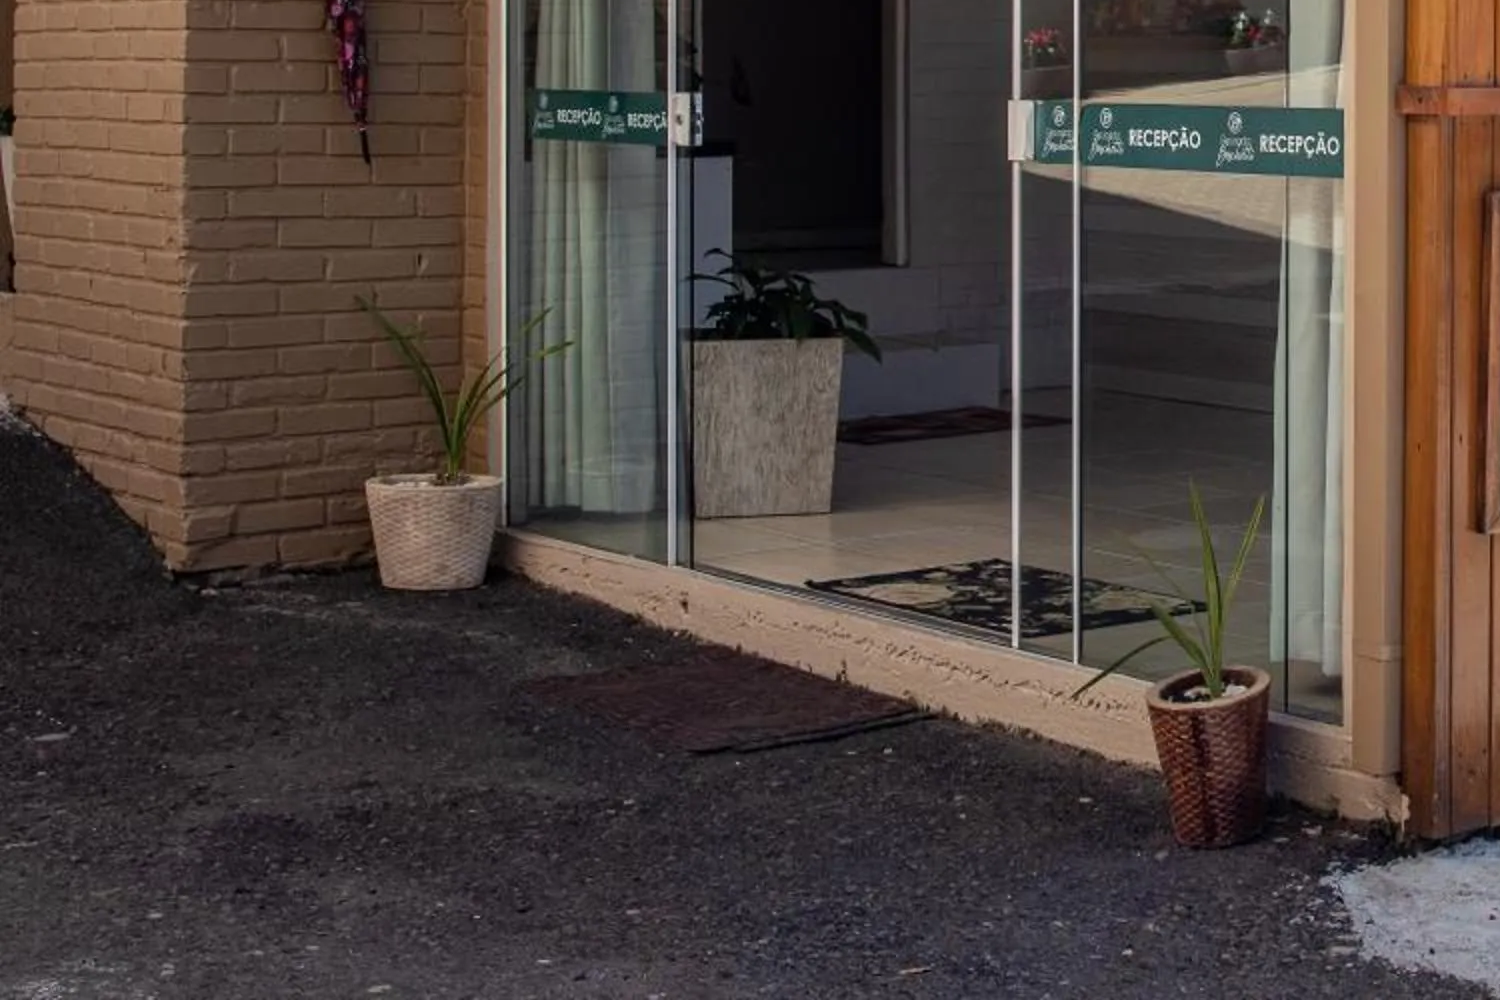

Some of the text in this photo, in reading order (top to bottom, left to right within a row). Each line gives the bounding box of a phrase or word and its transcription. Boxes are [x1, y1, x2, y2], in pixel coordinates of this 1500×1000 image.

[556, 107, 601, 126] RECEPÇÃO
[627, 111, 667, 131] RECEPÇÃ
[1128, 126, 1201, 151] RECEPÇÃO
[1259, 132, 1341, 159] RECEPÇÃO
